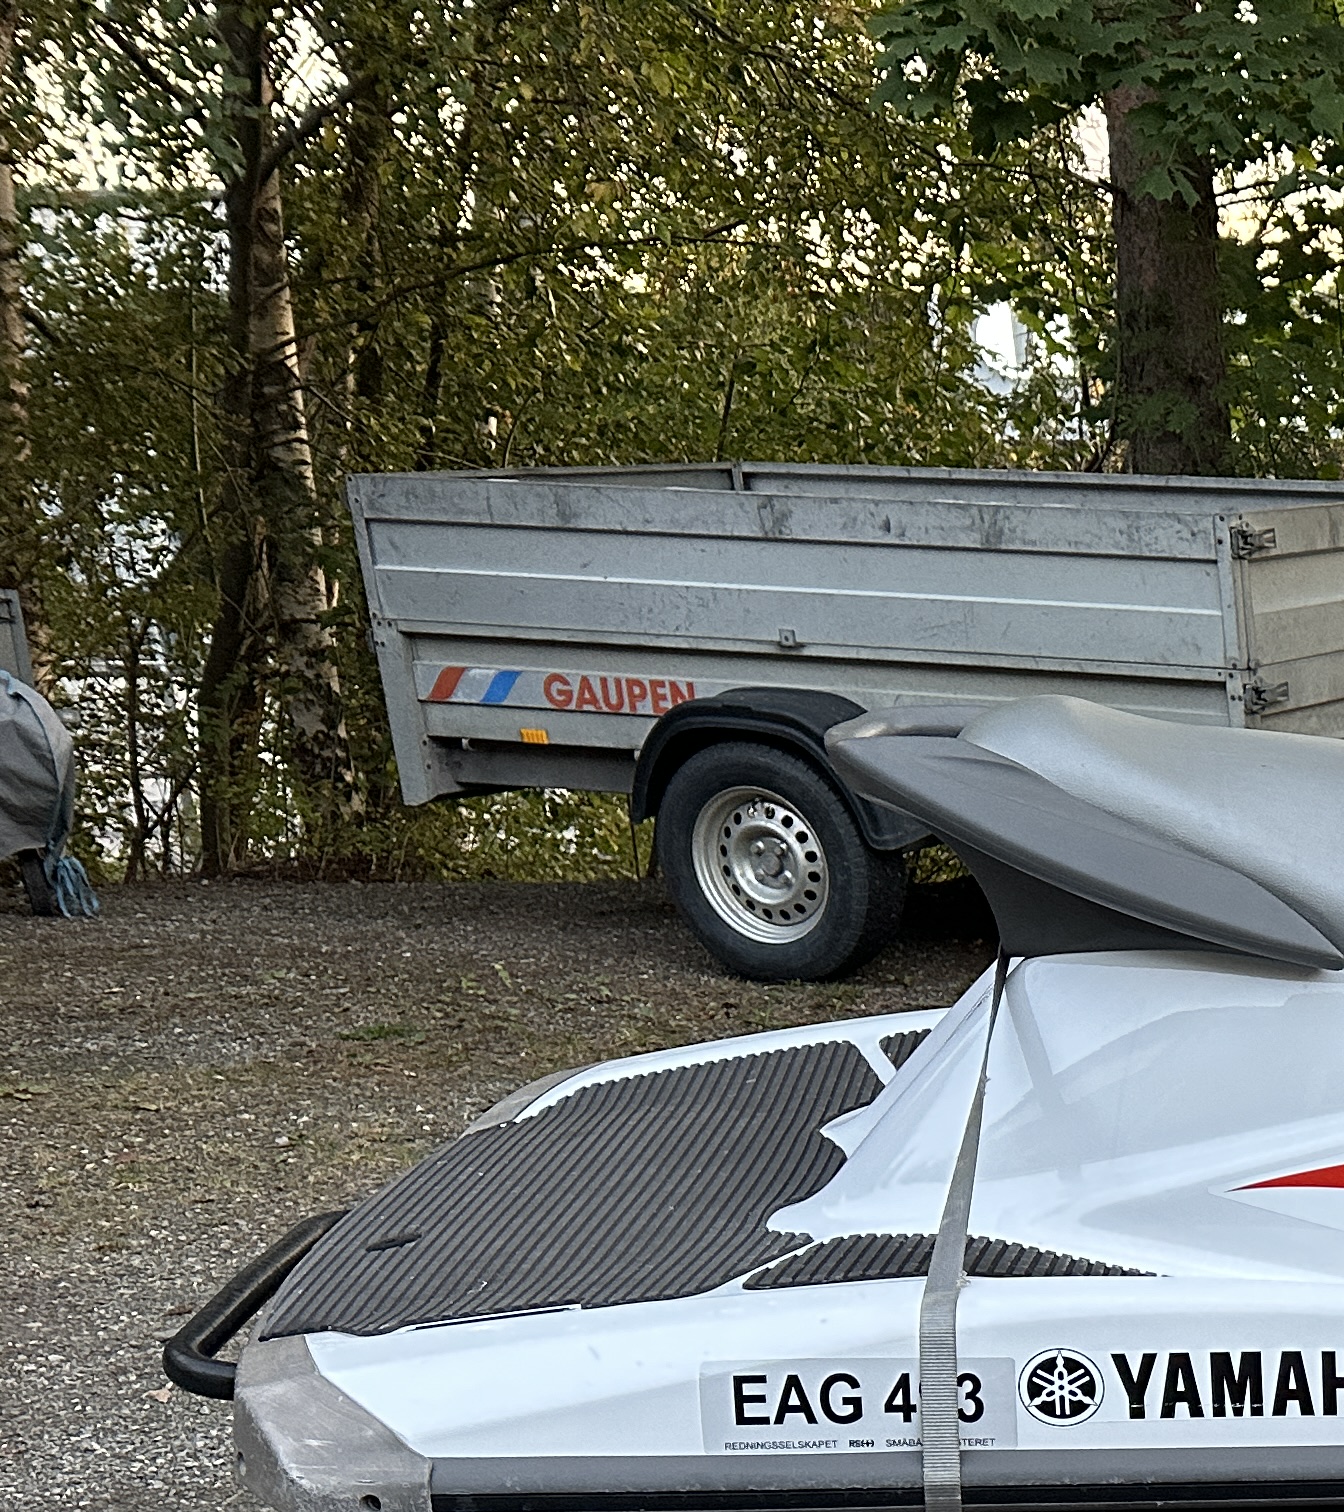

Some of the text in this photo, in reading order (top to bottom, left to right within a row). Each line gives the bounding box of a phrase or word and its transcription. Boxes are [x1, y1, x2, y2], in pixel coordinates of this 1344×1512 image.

[543, 672, 695, 714] GAUPEN
[732, 1372, 985, 1425] EAG 43
